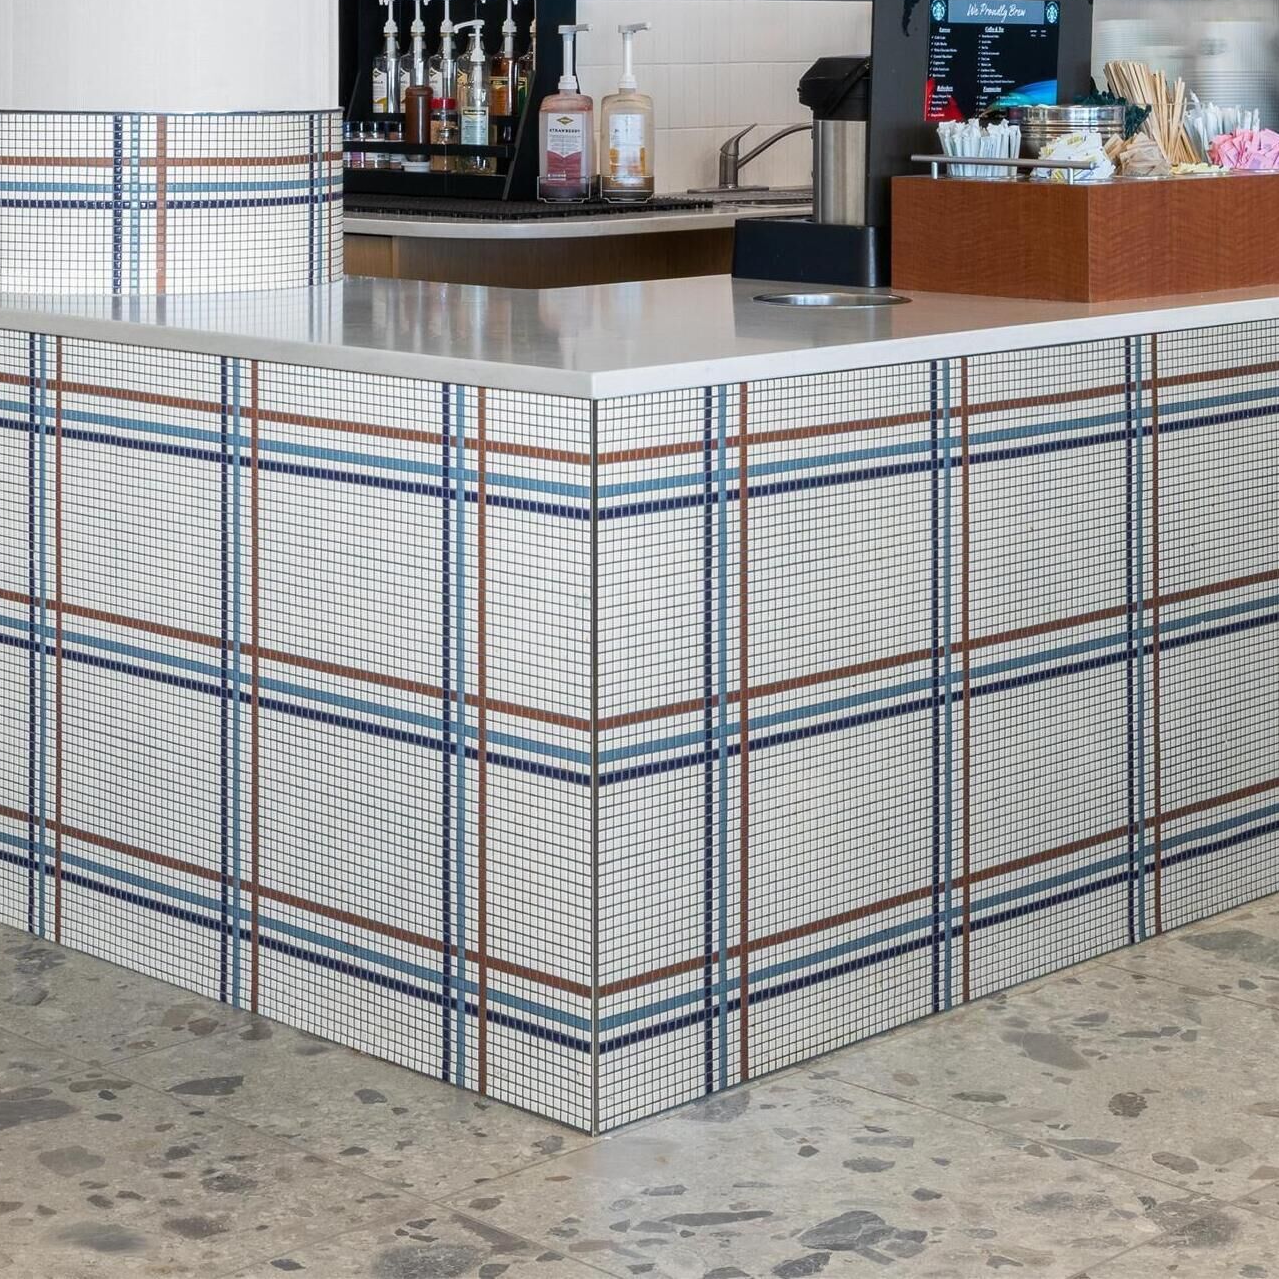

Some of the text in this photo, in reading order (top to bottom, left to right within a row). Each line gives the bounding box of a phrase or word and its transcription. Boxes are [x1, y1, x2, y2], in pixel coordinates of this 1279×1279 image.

[966, 3, 1026, 23] We Proudly Brew
